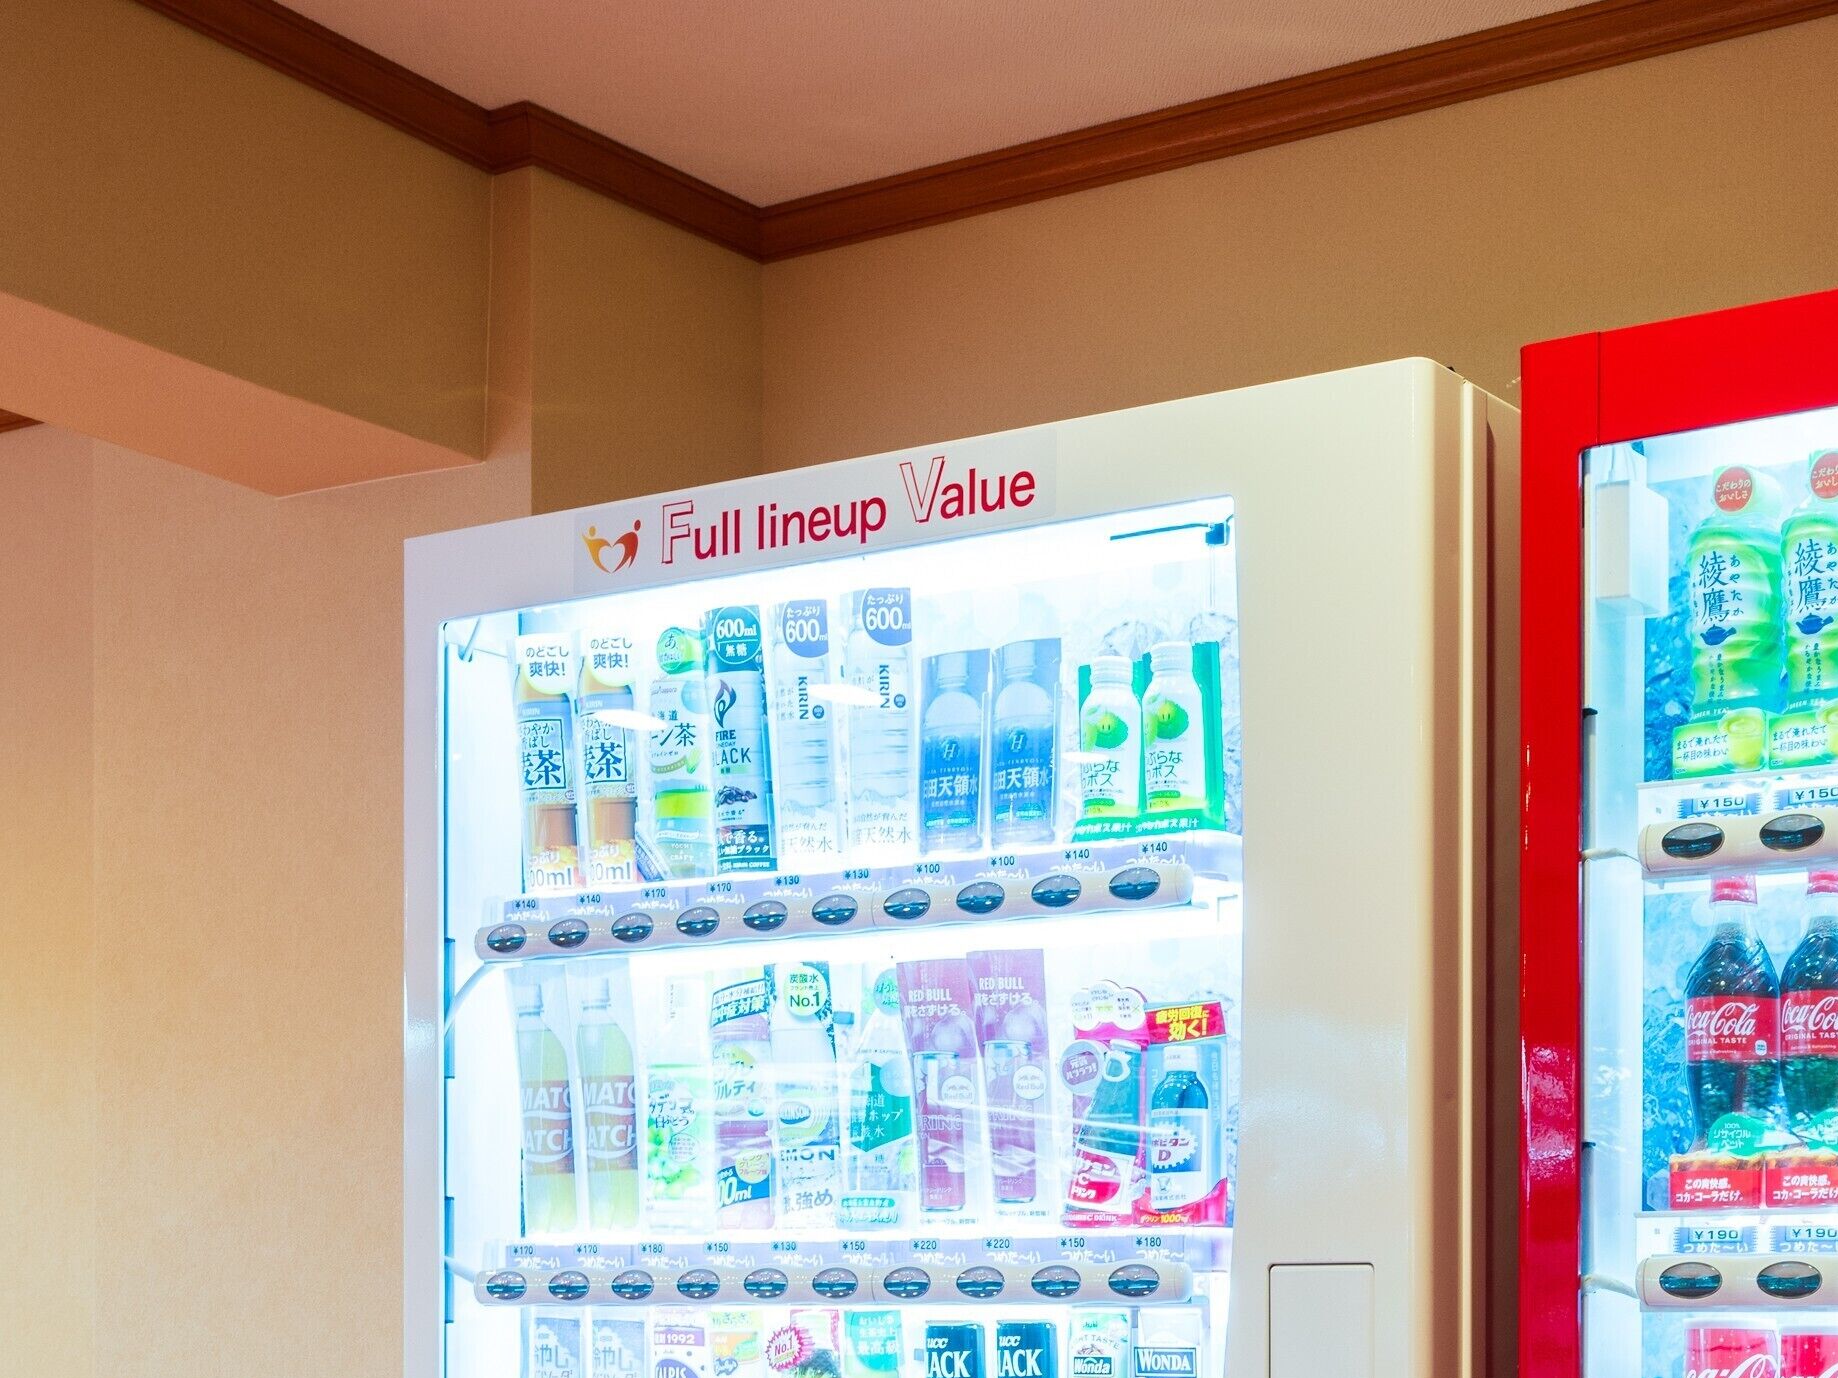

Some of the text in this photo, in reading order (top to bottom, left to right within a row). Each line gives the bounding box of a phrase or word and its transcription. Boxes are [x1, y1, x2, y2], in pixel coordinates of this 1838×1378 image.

[661, 457, 1036, 565] Full lineup Value
[786, 607, 820, 617] たっぷり
[716, 618, 757, 637] 600ml
[526, 647, 569, 657] のどごし
[799, 676, 809, 720] KIRIN
[1065, 849, 1089, 860] ¥140
[991, 856, 1014, 865] ¥100
[776, 876, 799, 885] ¥130
[979, 977, 1024, 990] RED BULL
[789, 992, 821, 1008] No.1
[1693, 1229, 1739, 1241] ¥190
[913, 1240, 937, 1249] ¥220
[1061, 1238, 1084, 1248] ¥150
[1136, 1237, 1161, 1247] ¥180
[1139, 1350, 1192, 1373] WONDA
[1073, 1360, 1111, 1375] Wonda
